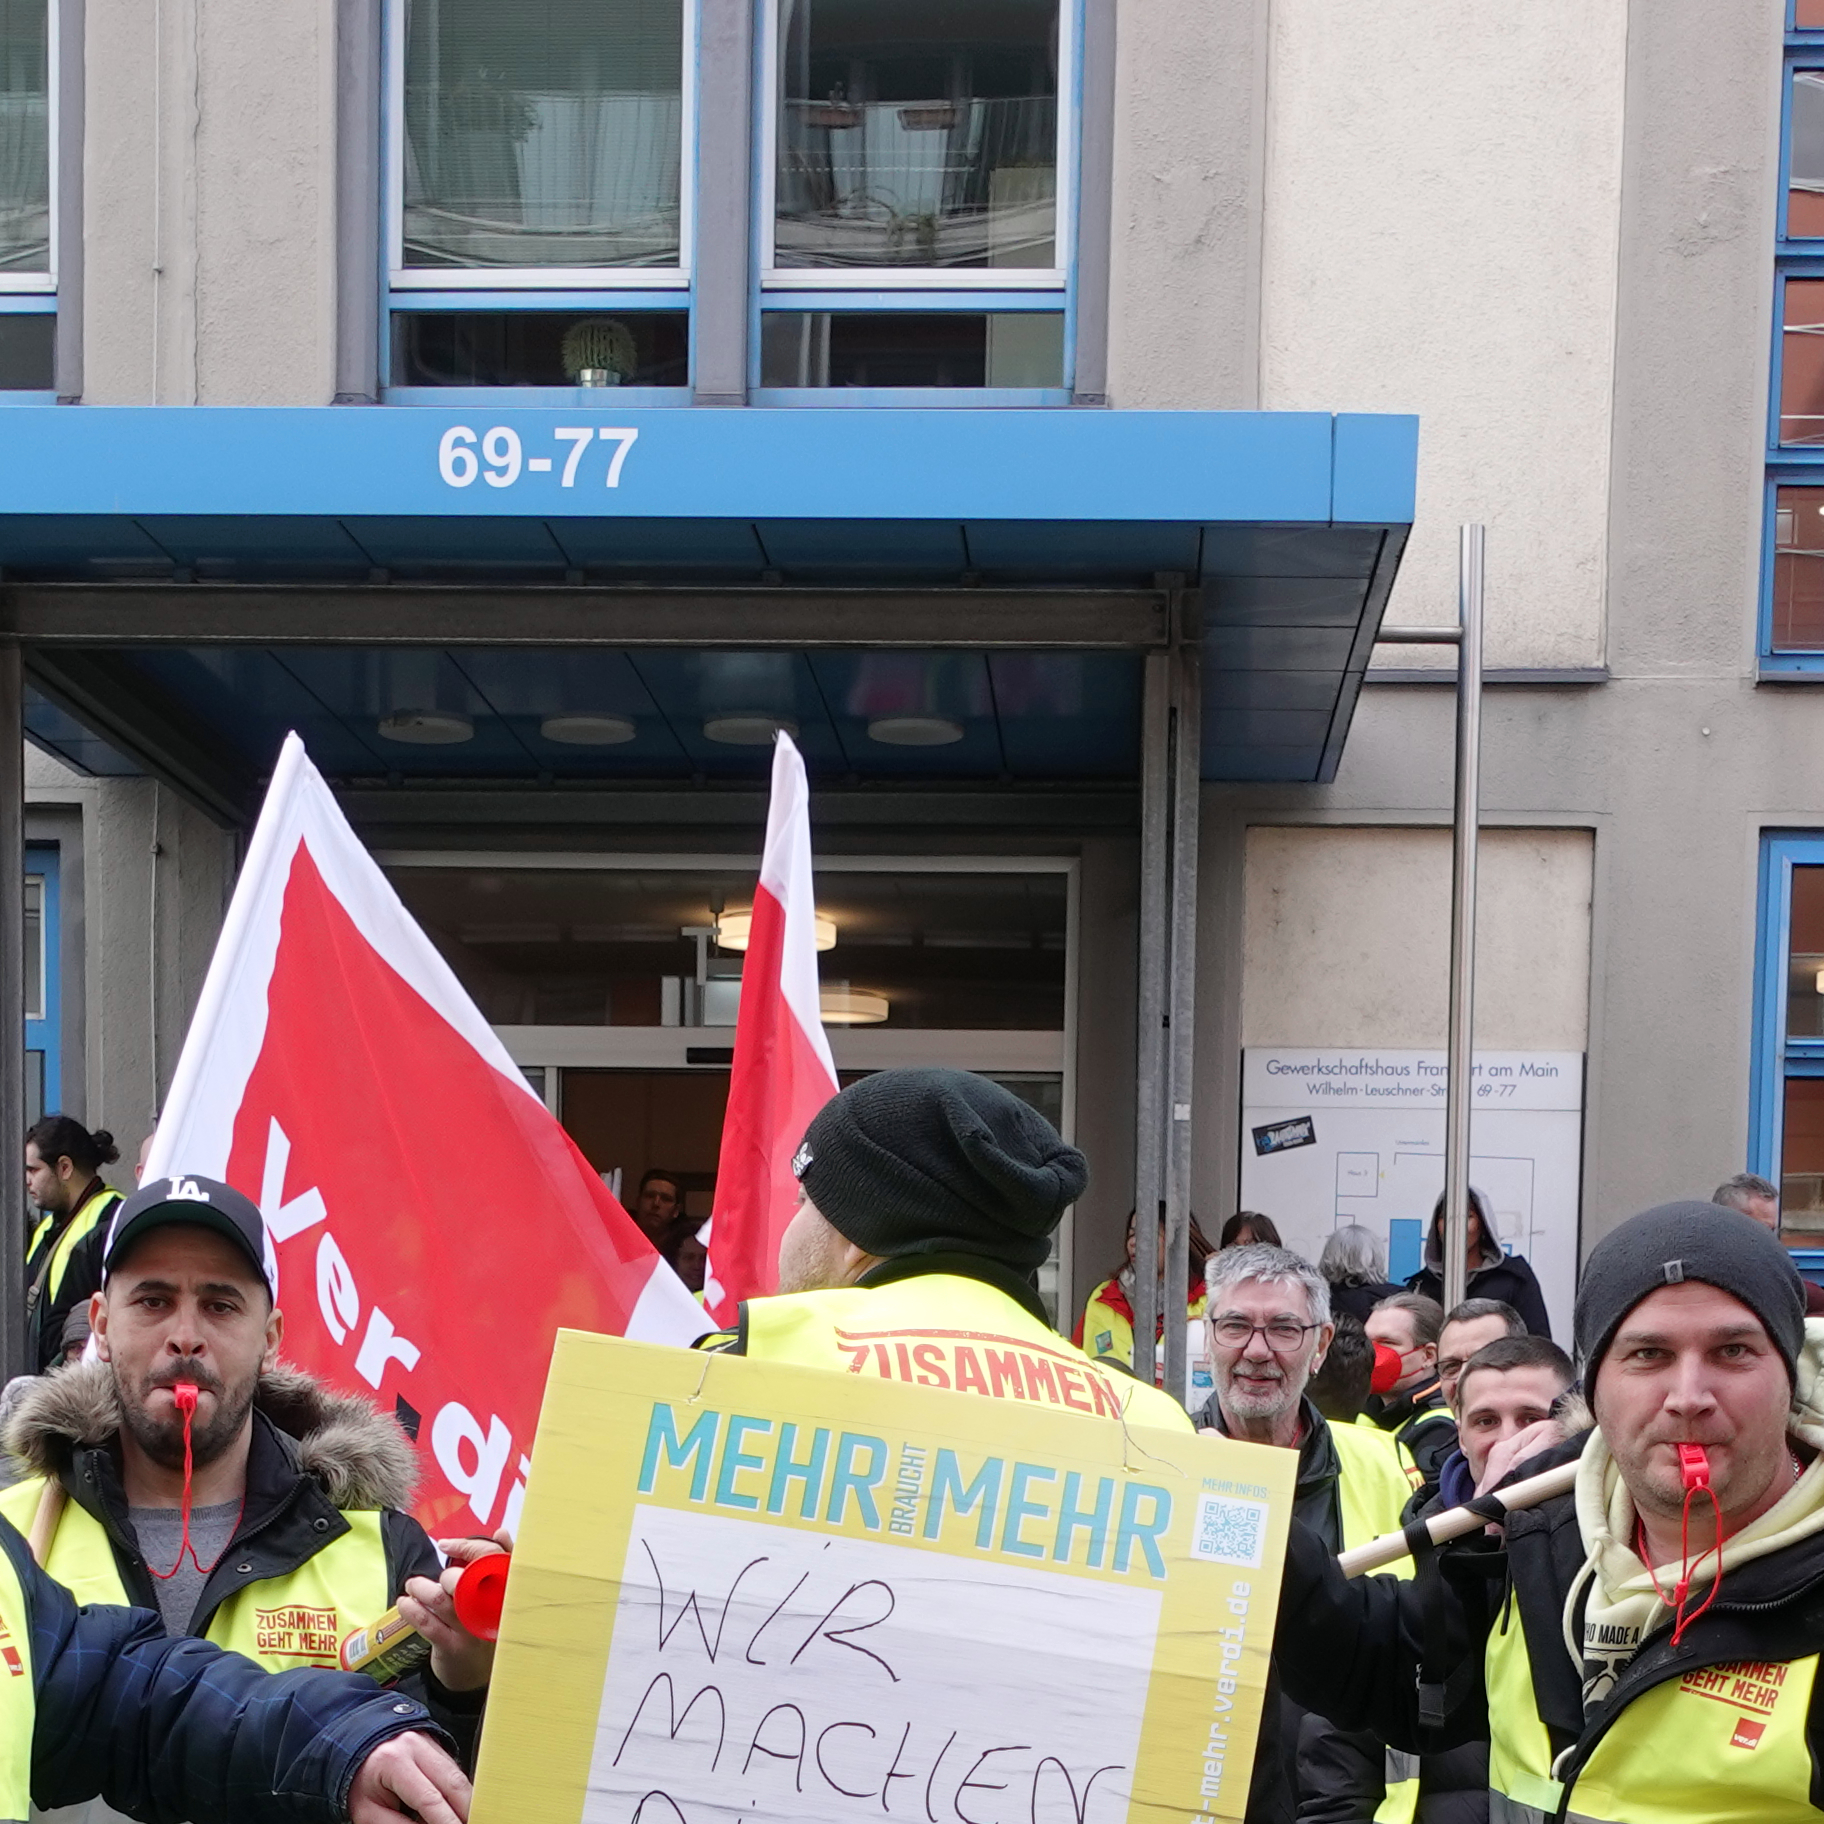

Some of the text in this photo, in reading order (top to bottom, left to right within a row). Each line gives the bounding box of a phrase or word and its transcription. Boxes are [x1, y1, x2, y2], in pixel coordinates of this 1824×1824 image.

[438, 425, 639, 488] 69-77
[1266, 1057, 1559, 1078] Gewerkschaftshaus Franrt am Main
[166, 1175, 210, 1203] LA
[837, 1341, 1122, 1420] ZUSAMMEN
[636, 1401, 1175, 1581] MEHR BRAUCHT MEHR
[1201, 1477, 1233, 1494] MEHR
[255, 1610, 337, 1632] ZUSAMMEN
[256, 1631, 337, 1652] GEHT MEHR
[1597, 1624, 1631, 1645] MADE
[1631, 1626, 1640, 1645] A
[1682, 1668, 1779, 1709] GEHT MEHR
